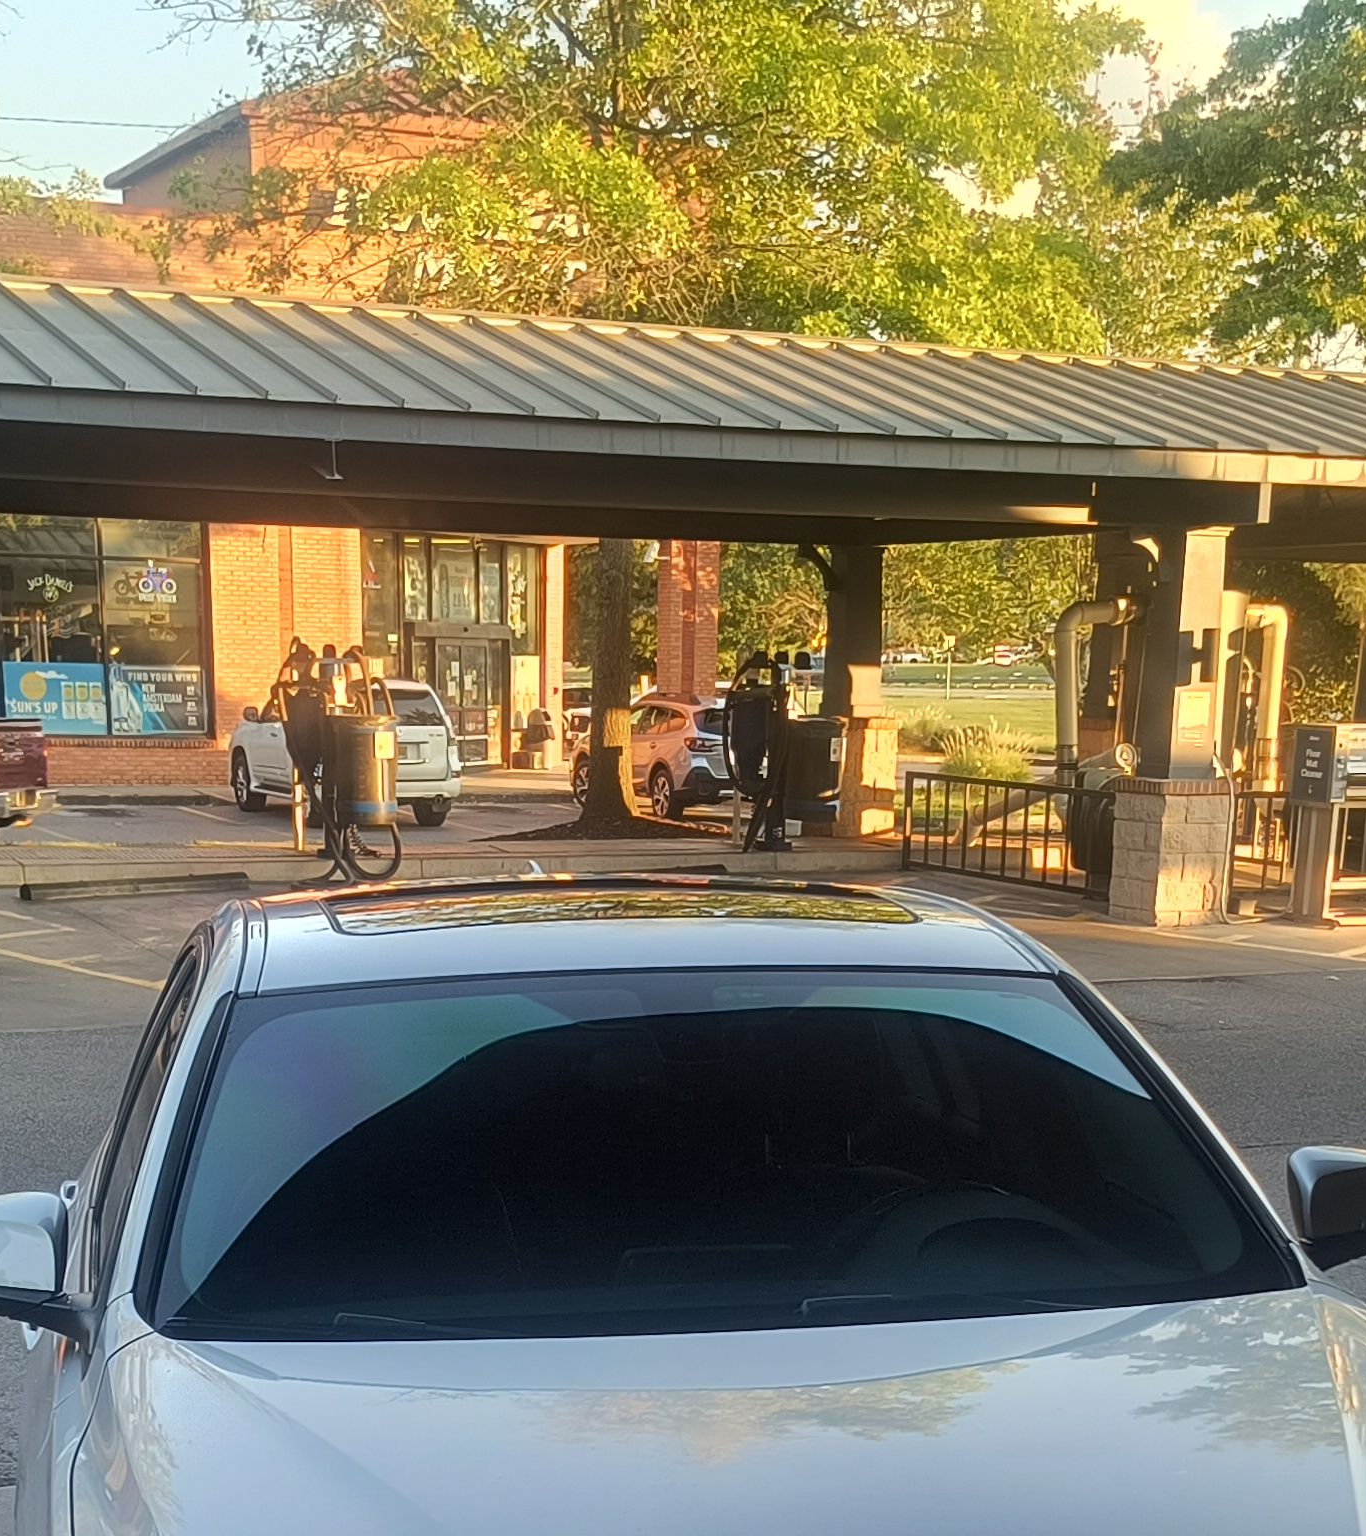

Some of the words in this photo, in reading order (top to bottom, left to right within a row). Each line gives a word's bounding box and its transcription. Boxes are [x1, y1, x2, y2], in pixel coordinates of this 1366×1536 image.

[128, 673, 149, 681] FIND
[150, 673, 173, 682] YOUR
[142, 684, 155, 693] NEW
[10, 701, 42, 714] SUN'S
[43, 701, 58, 713] UP
